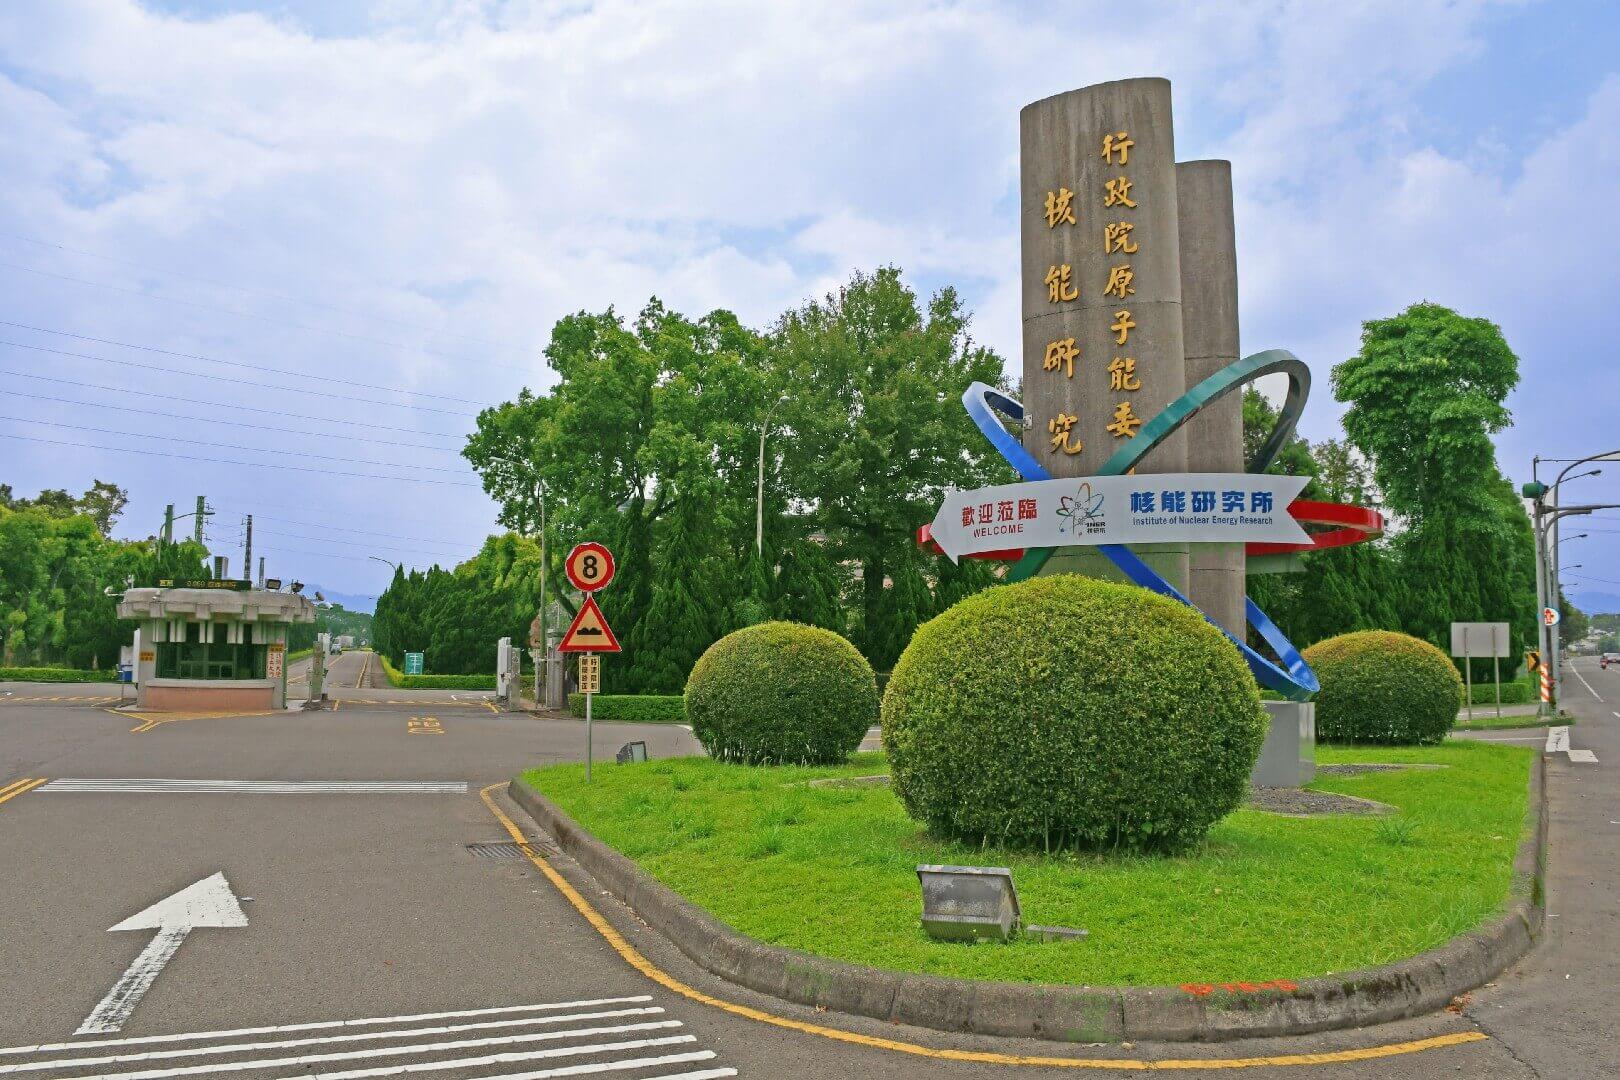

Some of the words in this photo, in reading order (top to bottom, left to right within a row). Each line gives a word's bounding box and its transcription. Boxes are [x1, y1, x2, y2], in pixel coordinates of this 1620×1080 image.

[1101, 131, 1143, 477] 行政院原子能委
[1130, 490, 1273, 513] 核能研究所
[962, 499, 1037, 528] 歡迎蒞臨
[1133, 516, 1167, 525] Institute
[1169, 516, 1177, 524] of
[1178, 516, 1209, 525] Nuclear
[1212, 516, 1238, 526] Energy
[1239, 516, 1273, 525] Research
[973, 524, 1024, 538] WELCOME
[583, 555, 598, 579] 8
